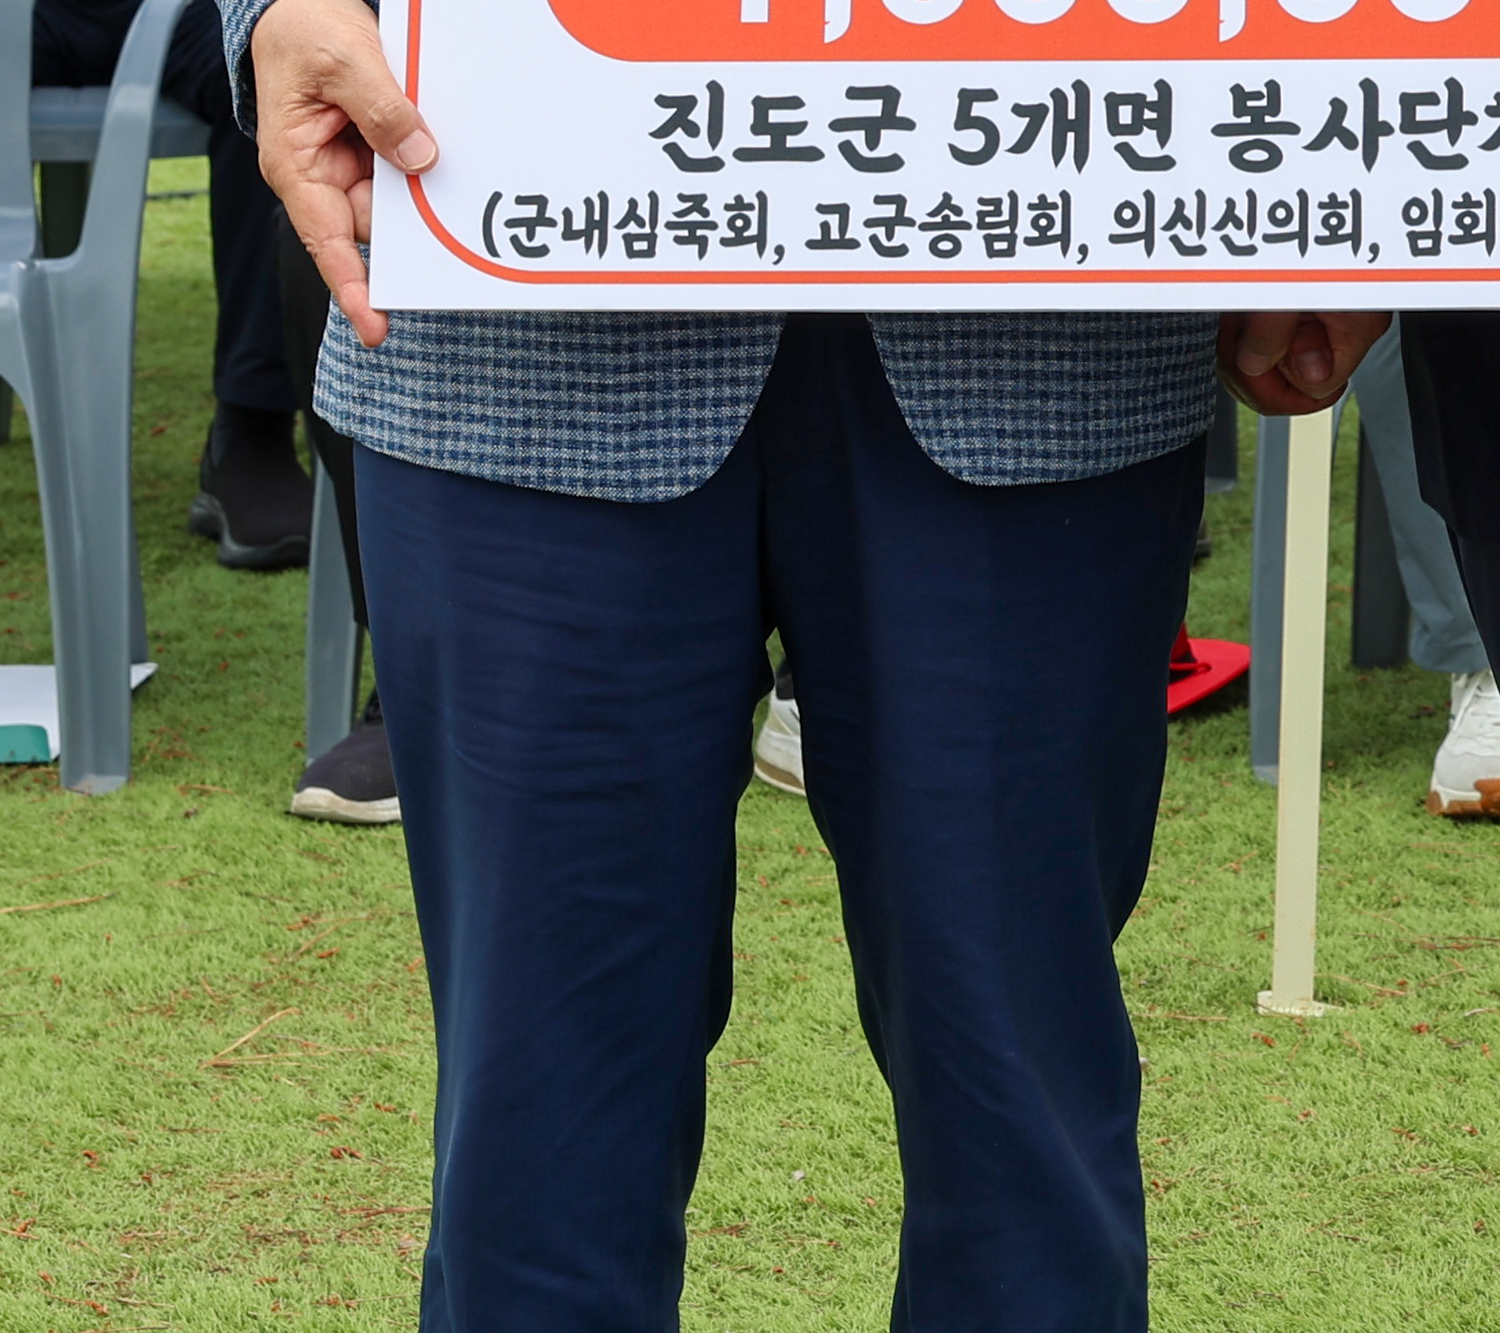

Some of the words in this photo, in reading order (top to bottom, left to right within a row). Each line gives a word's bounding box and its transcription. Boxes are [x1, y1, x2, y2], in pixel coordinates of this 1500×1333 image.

[648, 79, 919, 176] 진도군
[947, 78, 1179, 176] 5개면
[480, 190, 787, 266] (군내심죽회,
[804, 189, 1091, 265] 고군송림회,
[1107, 188, 1382, 264] 의신신의회,
